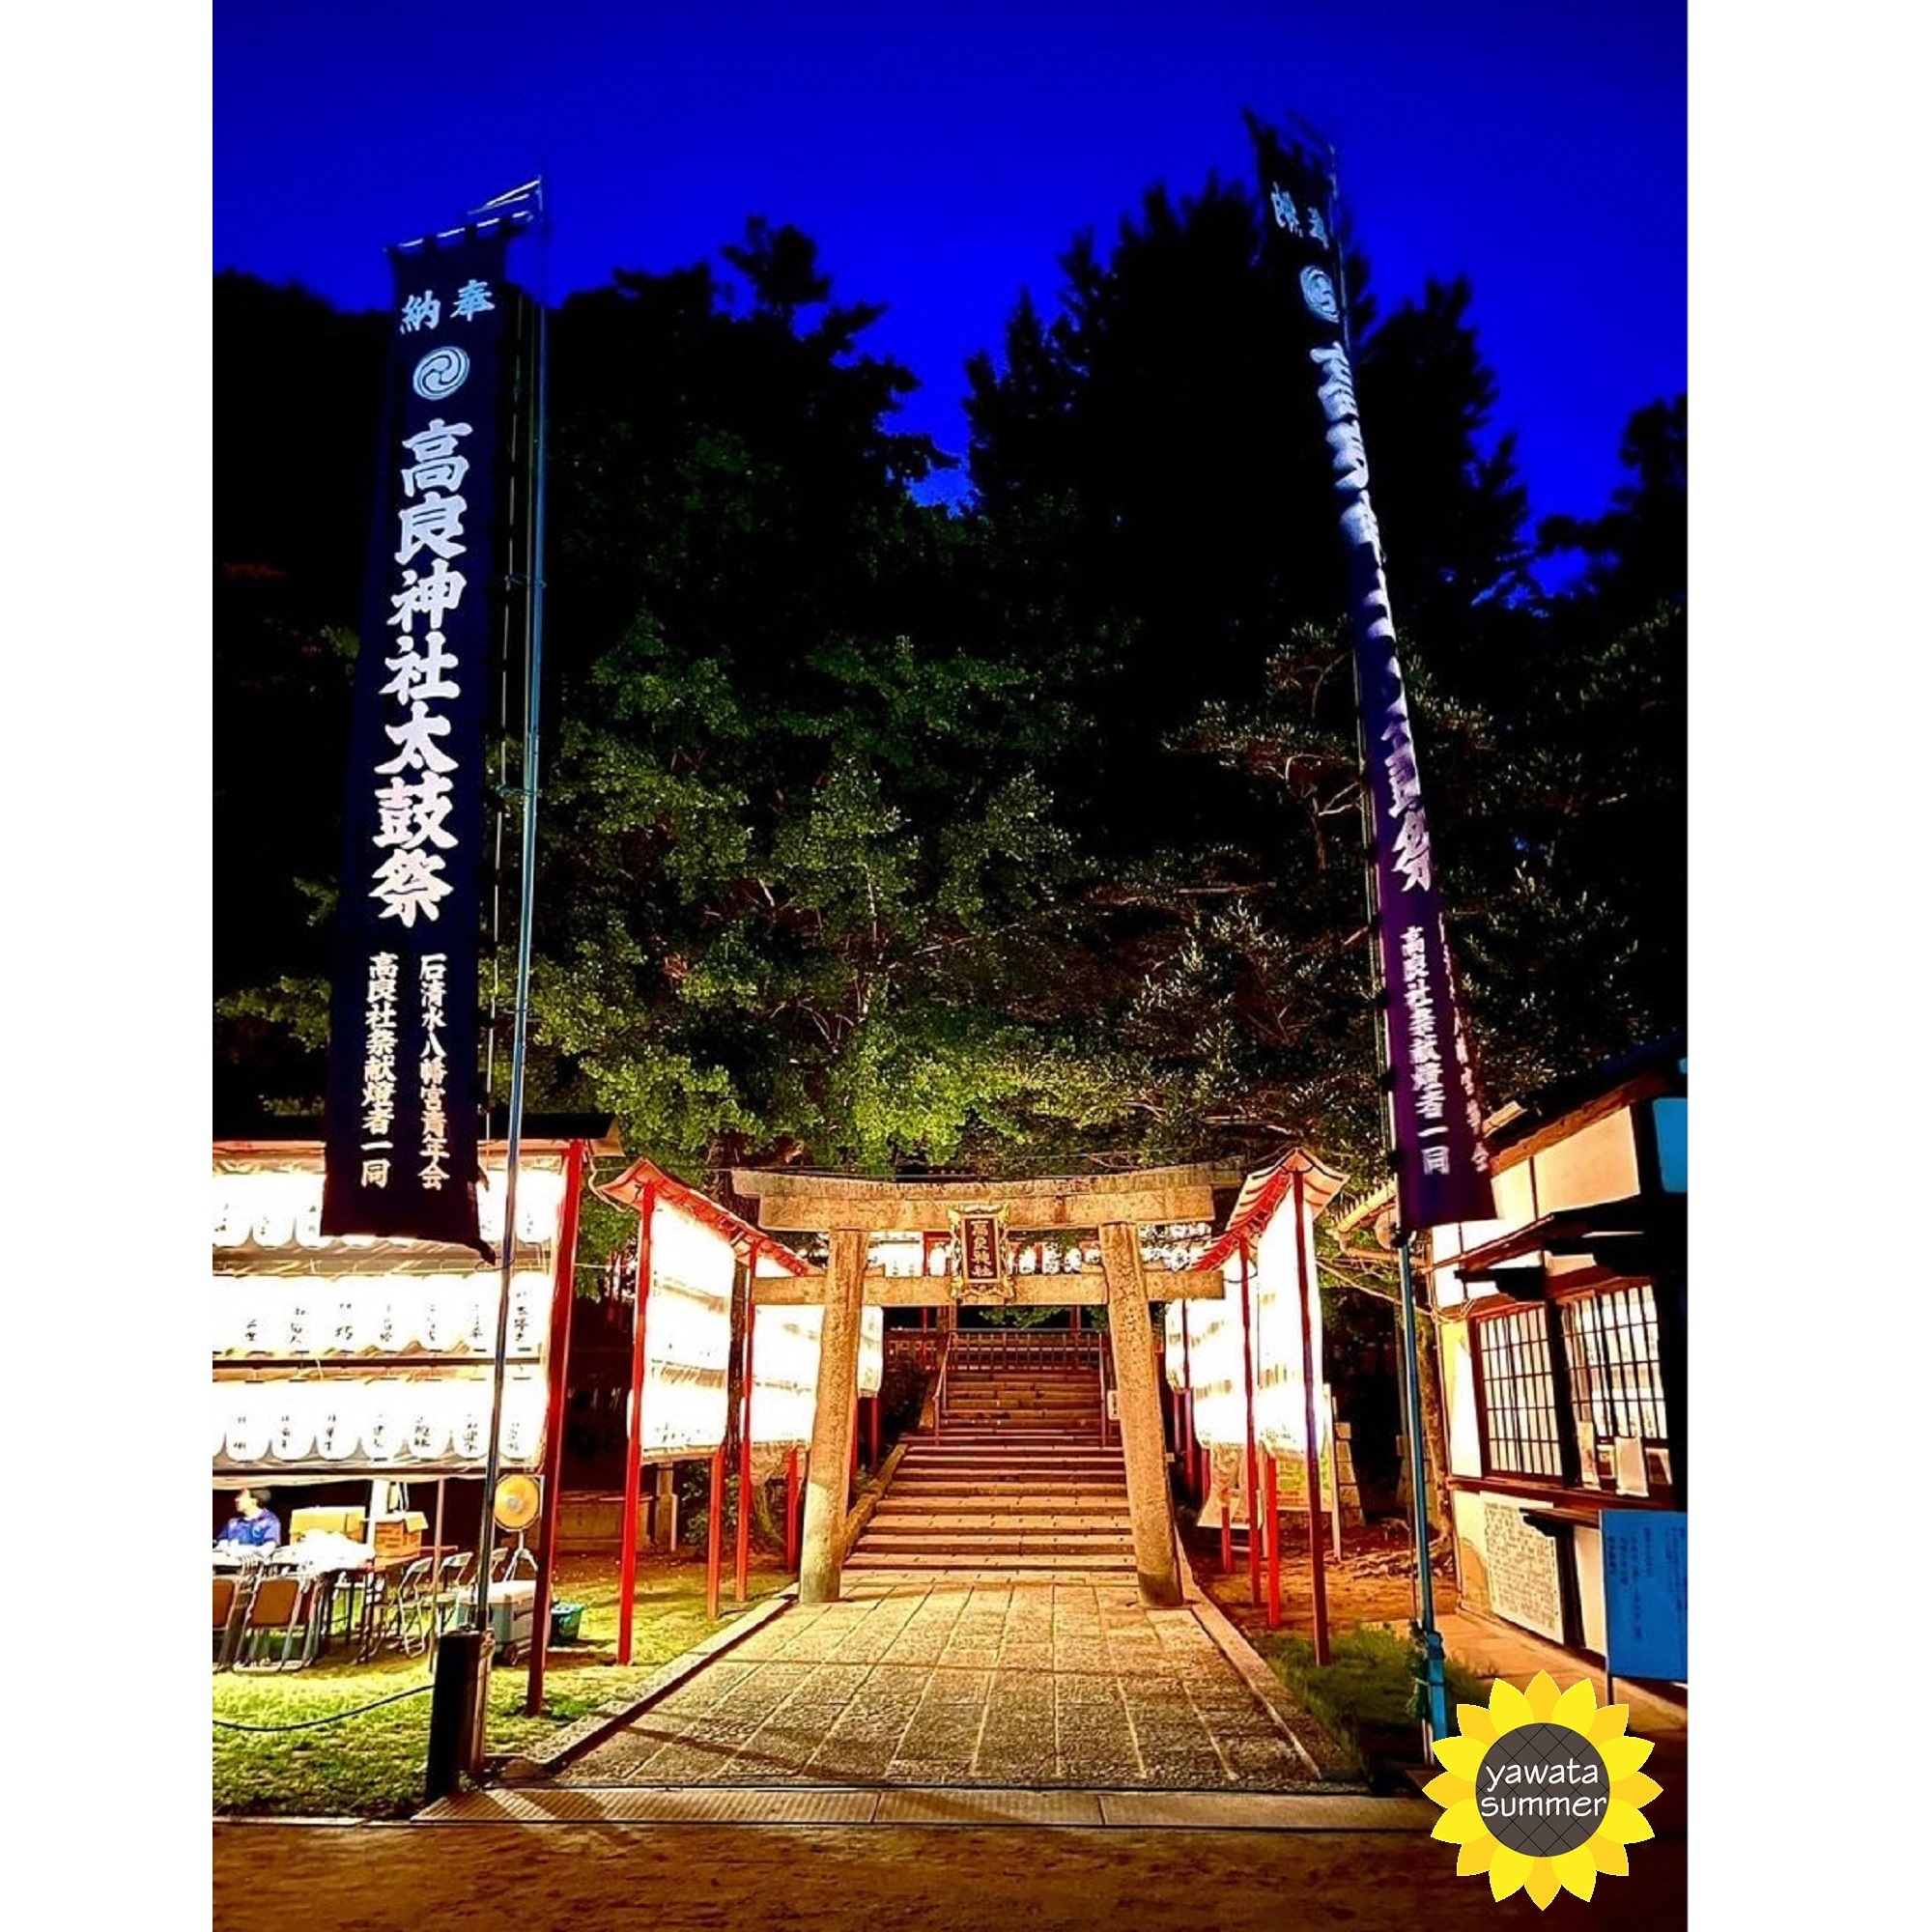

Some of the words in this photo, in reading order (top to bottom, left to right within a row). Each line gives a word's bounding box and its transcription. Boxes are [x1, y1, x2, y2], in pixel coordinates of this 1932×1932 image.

[368, 418, 473, 928] 高良神社太鼓祭
[416, 952, 451, 1191] 石清水八幡宮青年会
